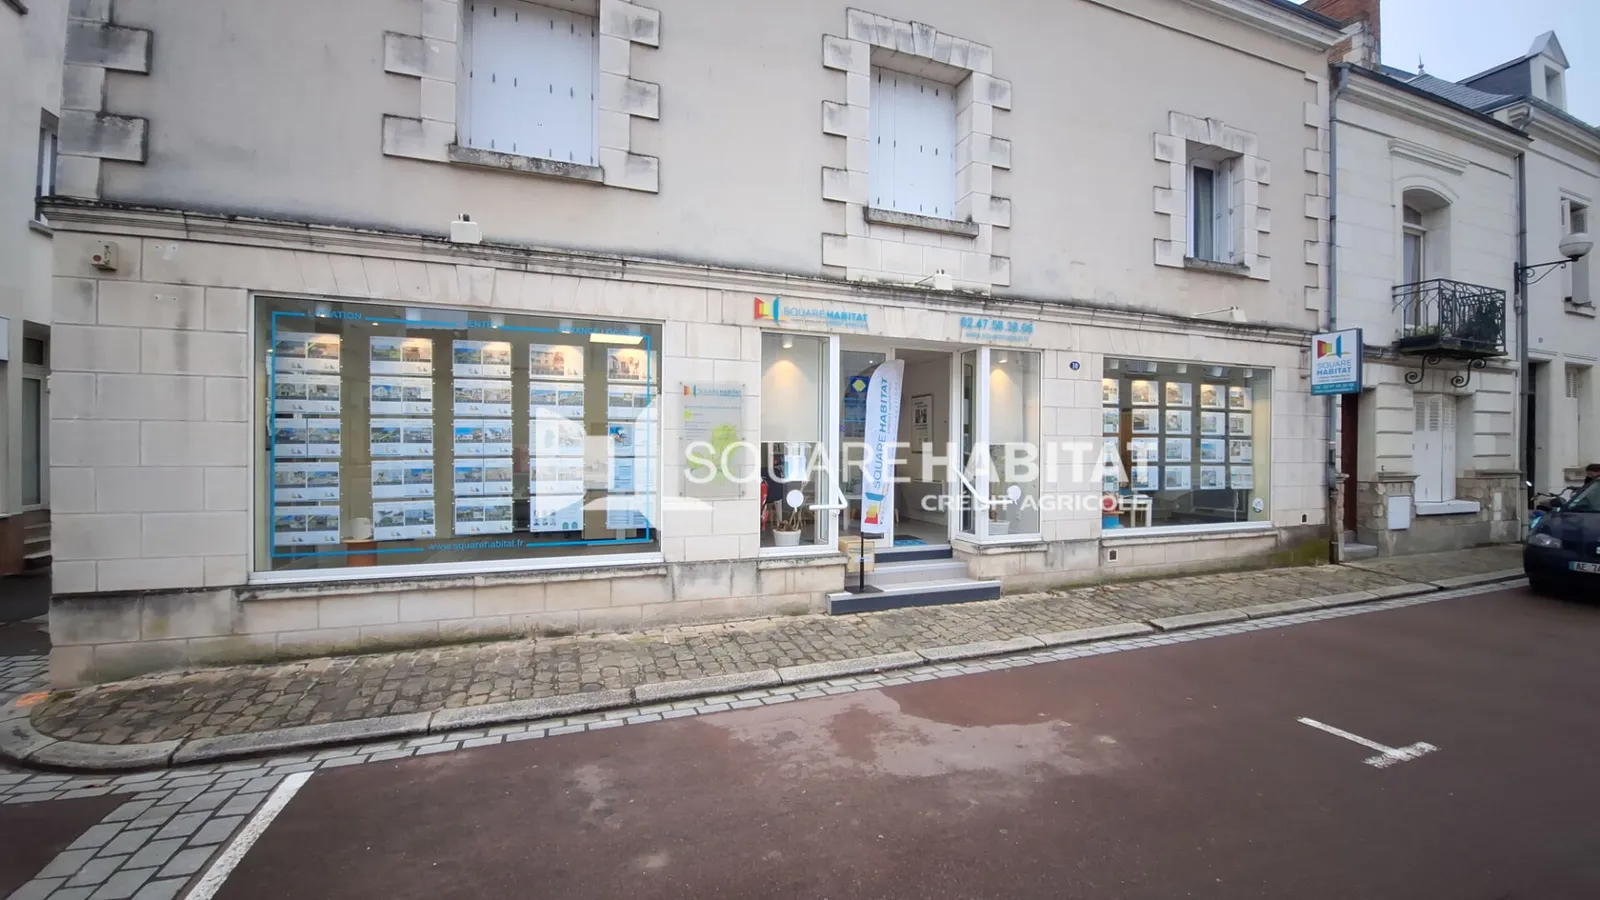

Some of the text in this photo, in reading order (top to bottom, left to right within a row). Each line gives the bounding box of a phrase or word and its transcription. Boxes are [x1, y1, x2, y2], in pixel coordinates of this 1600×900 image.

[783, 306, 868, 321] SQUARE HABITAT
[1316, 360, 1352, 369] SQUARE
[1317, 367, 1352, 375] HABITAT
[873, 377, 888, 490] SQUARE HABITAT
